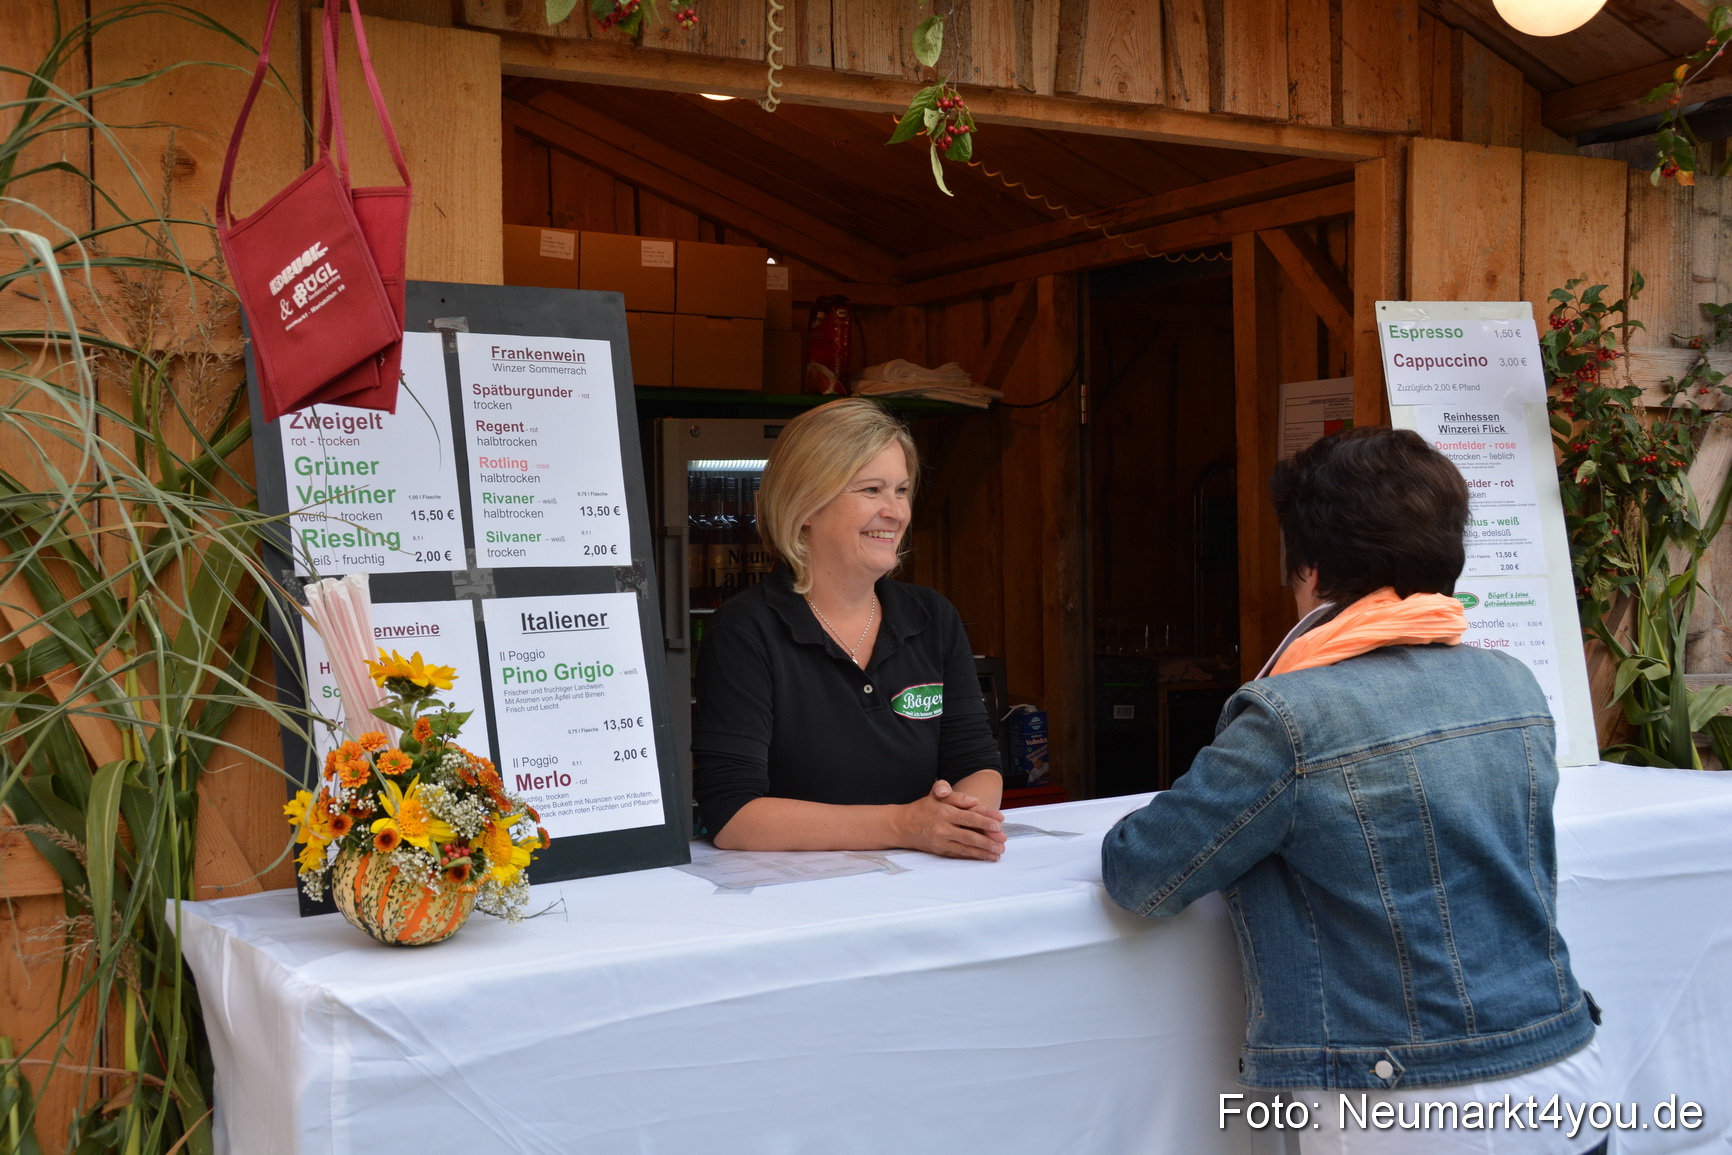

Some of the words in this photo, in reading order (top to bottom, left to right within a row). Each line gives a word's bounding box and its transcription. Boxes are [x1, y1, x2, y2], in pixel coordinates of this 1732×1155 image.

[279, 298, 294, 321] &
[1388, 324, 1464, 341] Espresso
[1494, 329, 1514, 339] 1,50
[1515, 329, 1522, 338] €
[491, 346, 586, 363] Frankenwein
[1393, 353, 1488, 371] Cappuccino
[1499, 357, 1519, 367] 3,00
[1521, 357, 1528, 366] €
[492, 363, 526, 373] Winzer
[528, 364, 587, 375] Sommerrach
[472, 383, 573, 400] Spätburgunder
[1397, 383, 1433, 393] Zuzüglich
[1434, 384, 1451, 392] 2,00
[1459, 383, 1481, 391] Pfand
[473, 400, 512, 410] trocken
[289, 412, 384, 434] Zweigelt
[1443, 412, 1500, 421] Reinhessen
[476, 420, 525, 435] Regent
[1438, 424, 1481, 434] Winzerei
[1482, 424, 1506, 434] Flick
[291, 437, 307, 446] rot
[317, 436, 360, 446] trocken
[477, 436, 538, 447] halbtrocken
[1435, 441, 1487, 450] Dornfelder
[1494, 441, 1516, 450] rose
[1489, 452, 1516, 460] lieblich
[294, 456, 380, 476] Grüner
[479, 456, 529, 472] Rotling
[480, 473, 541, 483] halbtrocken
[1500, 479, 1515, 488] rot
[295, 484, 397, 505] Veltliner
[482, 492, 535, 504] Rivaner
[1469, 491, 1487, 499] cken
[299, 511, 327, 522] weiß
[340, 511, 383, 521] trocken
[410, 509, 444, 522] 15,50
[446, 509, 456, 521] €
[483, 508, 544, 519] halbtrocken
[579, 505, 611, 518] 13,50
[613, 505, 621, 516] €
[1496, 517, 1520, 526] weiß
[301, 527, 401, 551] Riesling
[486, 530, 542, 543] Silvaner
[1482, 529, 1512, 537] edelsüß
[415, 550, 441, 564] 2,00
[444, 550, 453, 562] €
[487, 547, 527, 558] trocken
[583, 545, 607, 557] 2,00
[610, 544, 618, 555] €
[1495, 551, 1513, 559] 13,50
[303, 554, 331, 566] weiß
[343, 554, 385, 566] fruchtig
[1515, 563, 1520, 571] €
[520, 610, 608, 632] Italiener
[1467, 619, 1505, 629] nschorle
[373, 621, 440, 638] enweine
[1483, 638, 1510, 650] Spritz
[508, 649, 546, 663] Poggio
[502, 666, 548, 685] Pino
[553, 661, 615, 683] Grigio
[623, 668, 638, 676] weiß
[503, 688, 529, 697] Frischer
[530, 686, 543, 694] und
[543, 685, 573, 694] fruchtiger
[504, 697, 514, 705] Mit
[515, 696, 541, 705] Aromen
[541, 695, 553, 703] von
[554, 692, 571, 703] Äpfel
[572, 692, 584, 700] und
[584, 690, 605, 699] Birnen
[505, 706, 526, 714] Frisch
[526, 704, 539, 712] und
[539, 702, 559, 711] Leicht
[603, 718, 634, 731] 13,50
[636, 716, 644, 727] €
[613, 749, 638, 762] 2,00
[640, 747, 648, 758] €
[522, 754, 559, 770] Poggio
[515, 770, 572, 792] Merlo
[522, 794, 545, 804] uchtig,
[545, 792, 569, 801] trocken
[552, 800, 573, 809] Bukett
[573, 799, 584, 807] mit
[585, 796, 612, 806] Nuancen
[613, 794, 625, 802] von
[539, 810, 557, 818] mack
[557, 809, 574, 817] nach
[574, 806, 591, 815] roten
[591, 802, 620, 813] Früchten
[620, 801, 632, 810] und
